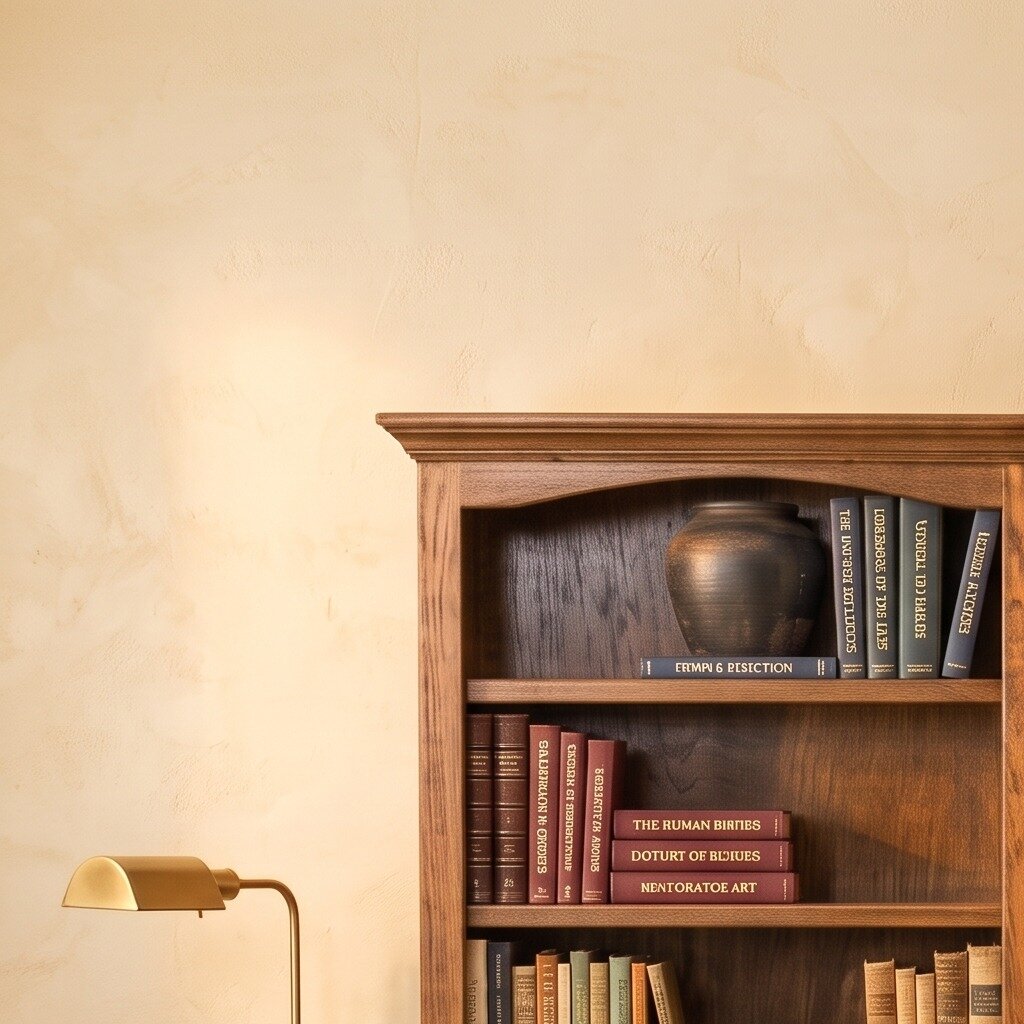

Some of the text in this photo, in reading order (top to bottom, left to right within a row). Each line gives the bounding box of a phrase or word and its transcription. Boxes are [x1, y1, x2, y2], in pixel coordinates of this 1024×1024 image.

[632, 819, 660, 831] THE
[662, 819, 711, 831] RUMAN
[631, 850, 686, 862] DOTURT
[688, 850, 707, 862] OF
[730, 882, 758, 893] ART
